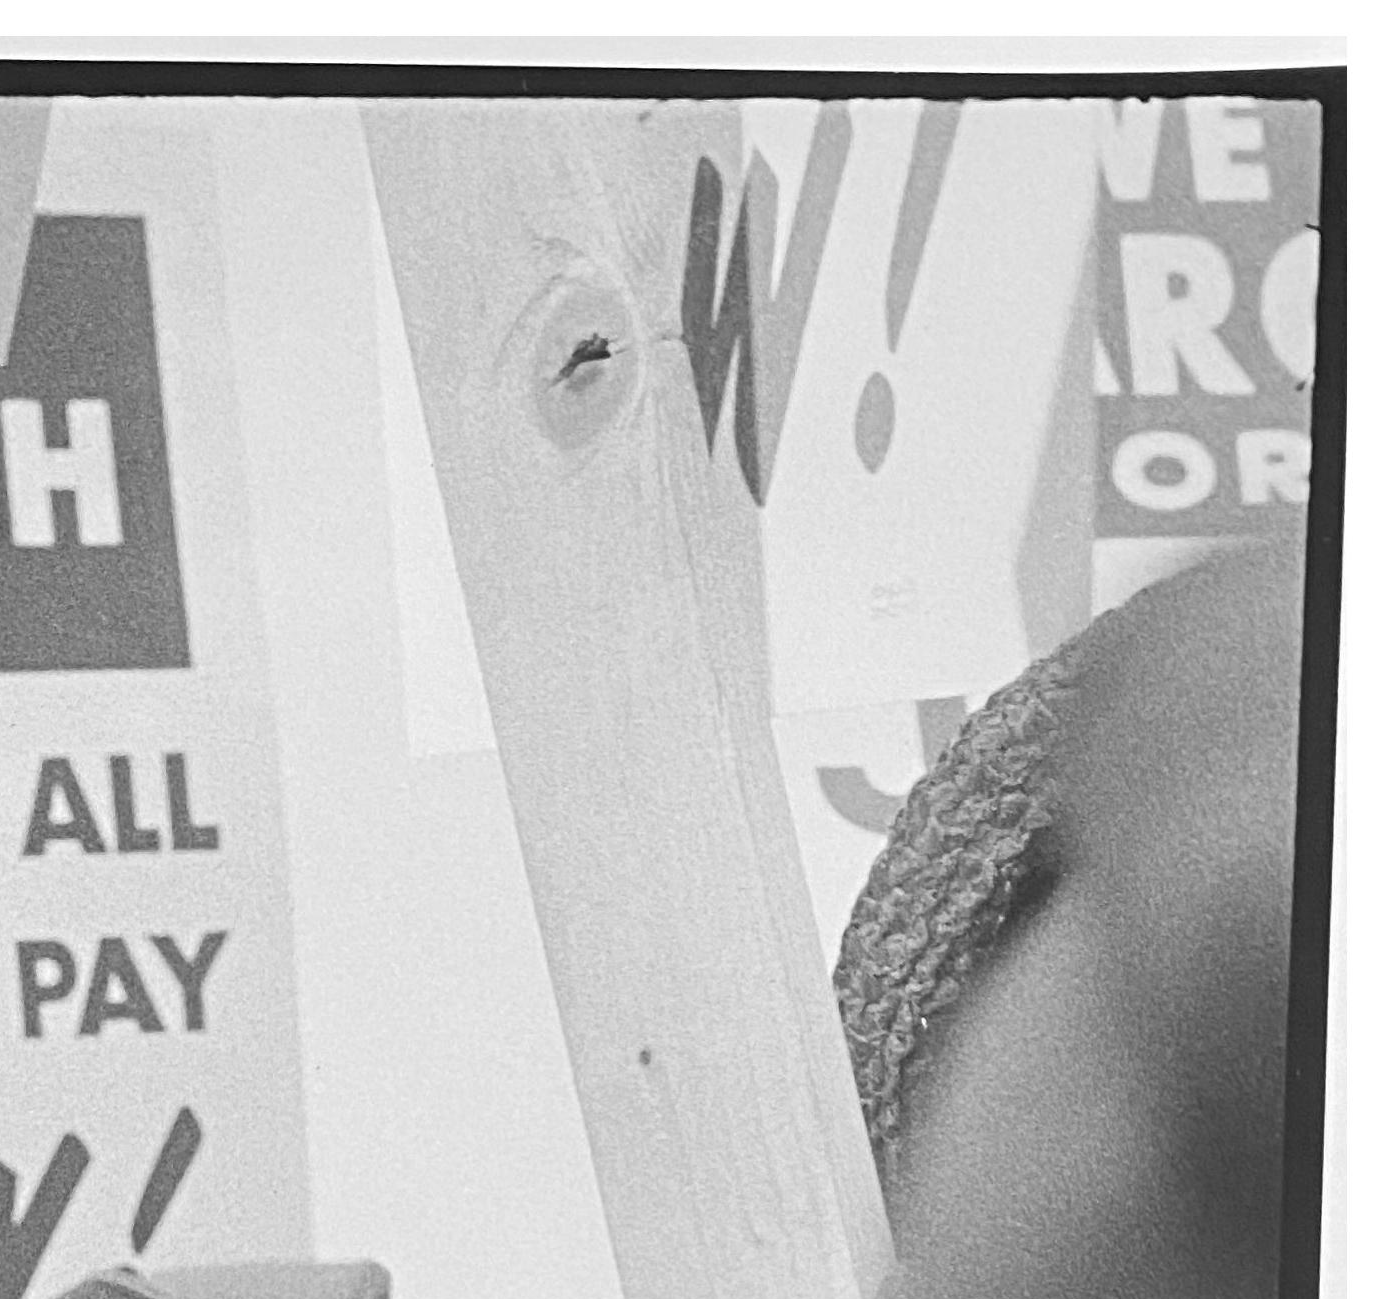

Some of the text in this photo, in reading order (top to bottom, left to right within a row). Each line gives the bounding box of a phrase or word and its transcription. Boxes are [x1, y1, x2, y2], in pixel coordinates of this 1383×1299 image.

[1113, 429, 1313, 511] OR
[22, 751, 221, 857] ALL
[15, 930, 228, 1040] PAY
